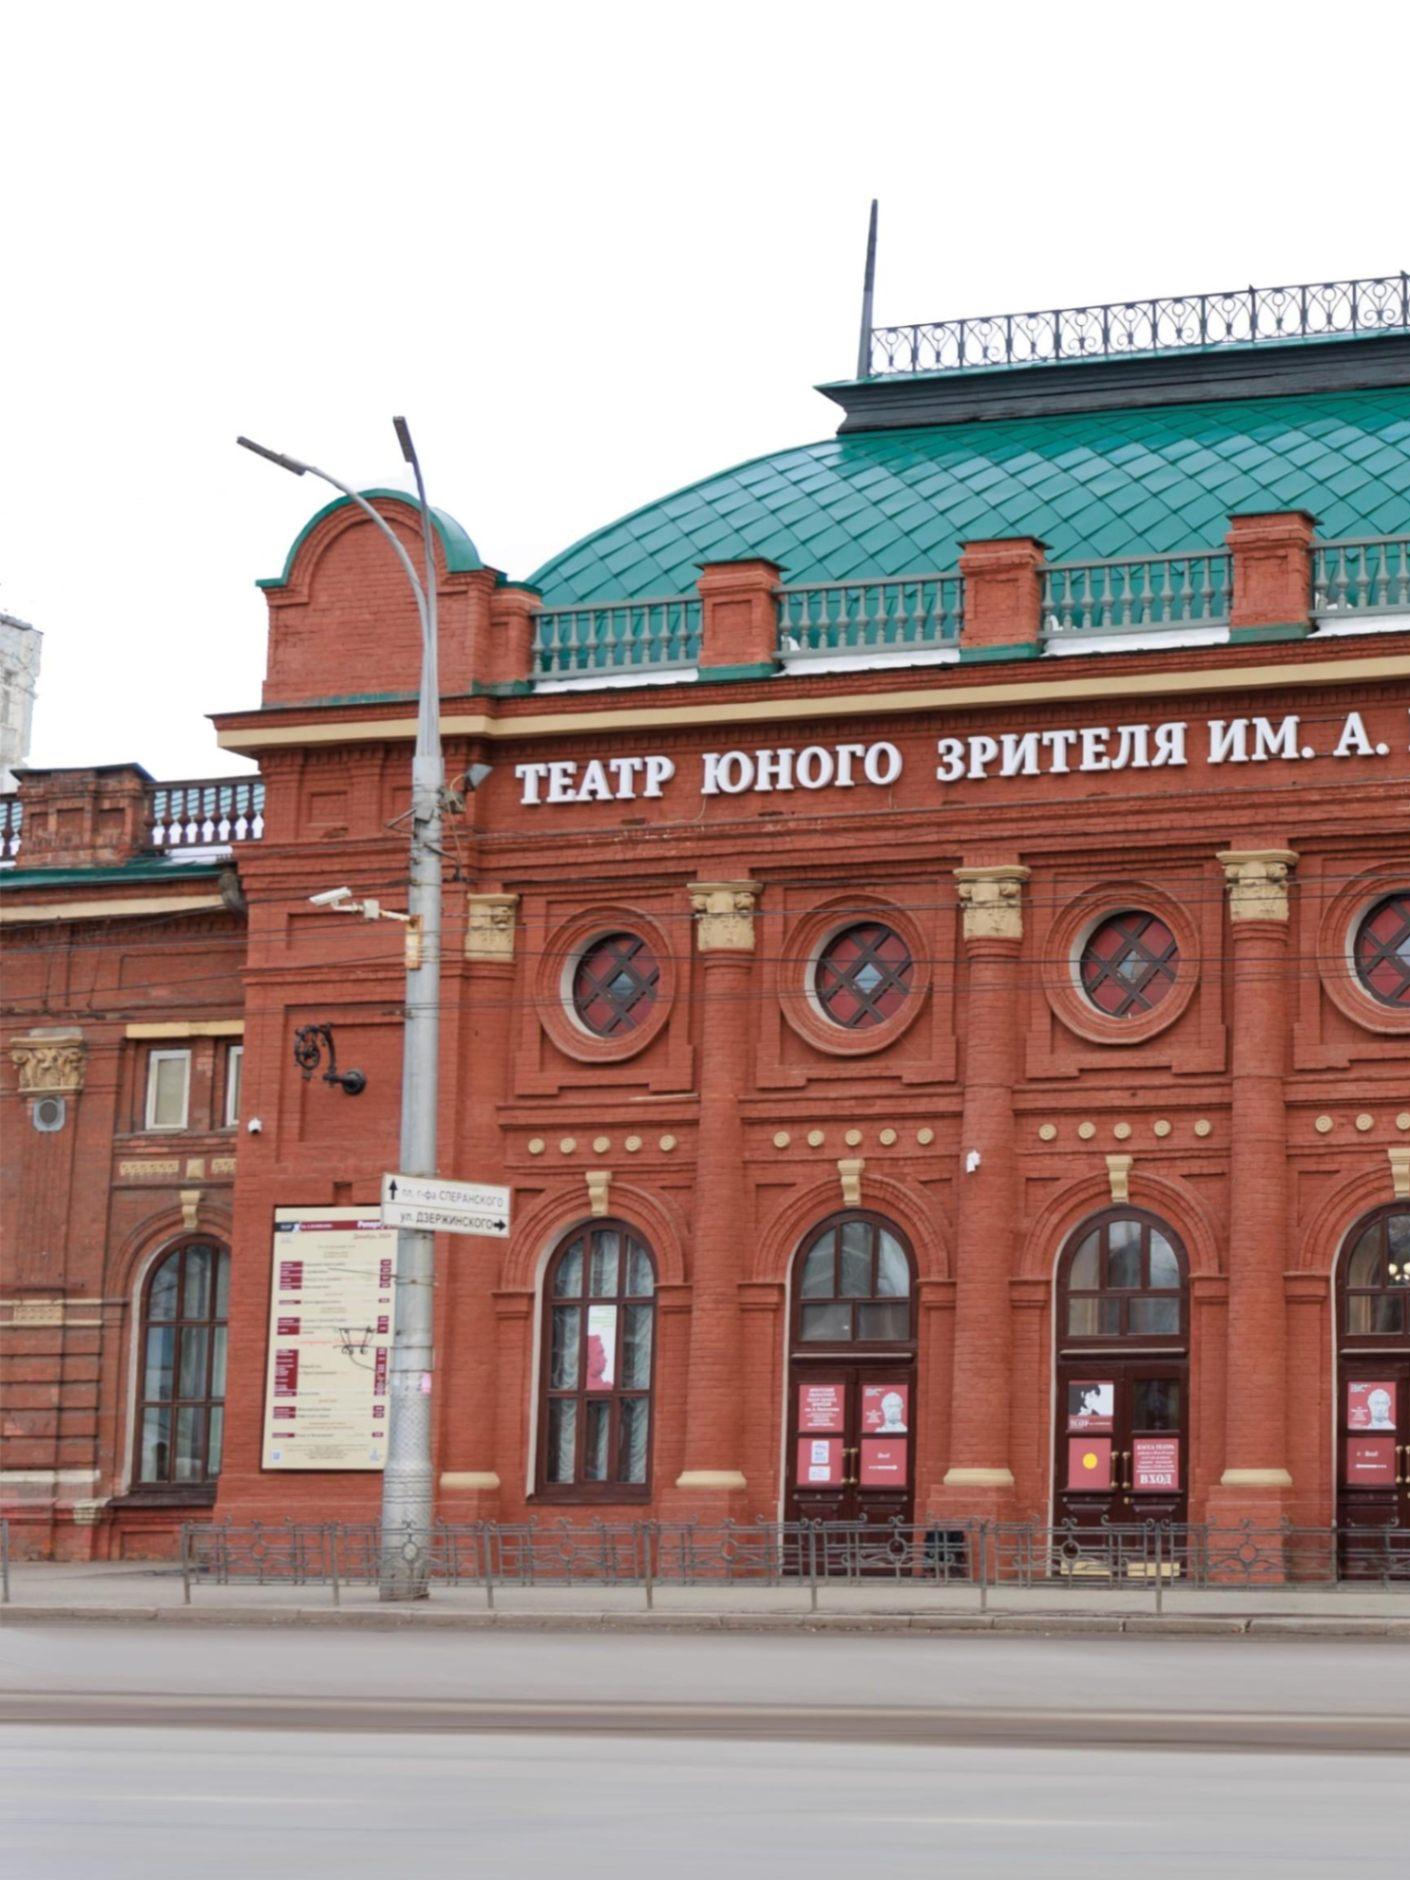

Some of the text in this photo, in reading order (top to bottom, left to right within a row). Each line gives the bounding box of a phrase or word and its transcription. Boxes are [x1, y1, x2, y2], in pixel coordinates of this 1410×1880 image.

[515, 755, 675, 805] ТЕАТР
[700, 741, 903, 795] ЮНОГО
[936, 721, 1189, 782] ЗРИТЕЛЯ
[1206, 715, 1317, 763] ИМ.
[1332, 711, 1390, 757] А.
[439, 1190, 504, 1208] СПЕРАНСКОГО
[416, 1211, 494, 1230] ДЗЕРЖИНСКОГО
[1140, 1474, 1171, 1485] ВХОД
